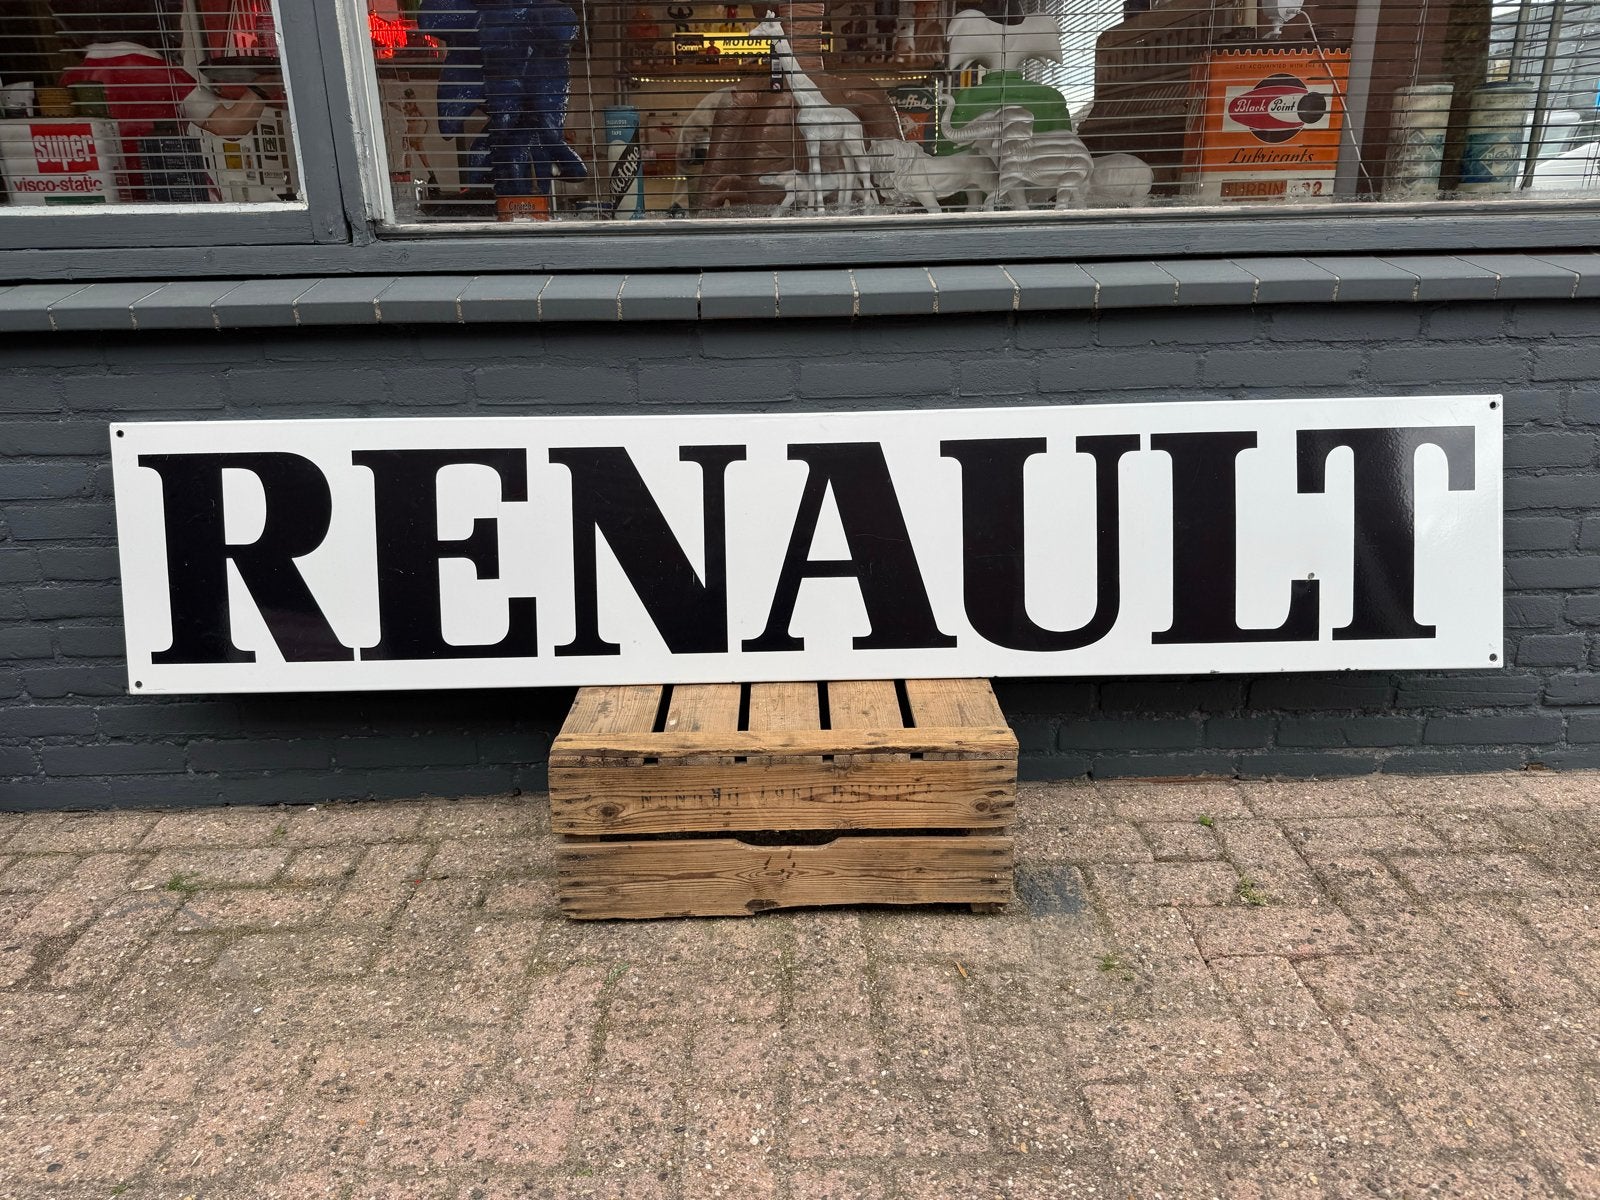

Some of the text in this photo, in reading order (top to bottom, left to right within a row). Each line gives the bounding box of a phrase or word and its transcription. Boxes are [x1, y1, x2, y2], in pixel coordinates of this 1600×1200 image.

[722, 39, 761, 47] MOTOR
[1234, 98, 1296, 113] Black Point
[33, 134, 94, 171] super
[1228, 147, 1315, 164] Lubricants
[13, 176, 103, 193] visco-static
[137, 424, 1477, 665] RENAULT
